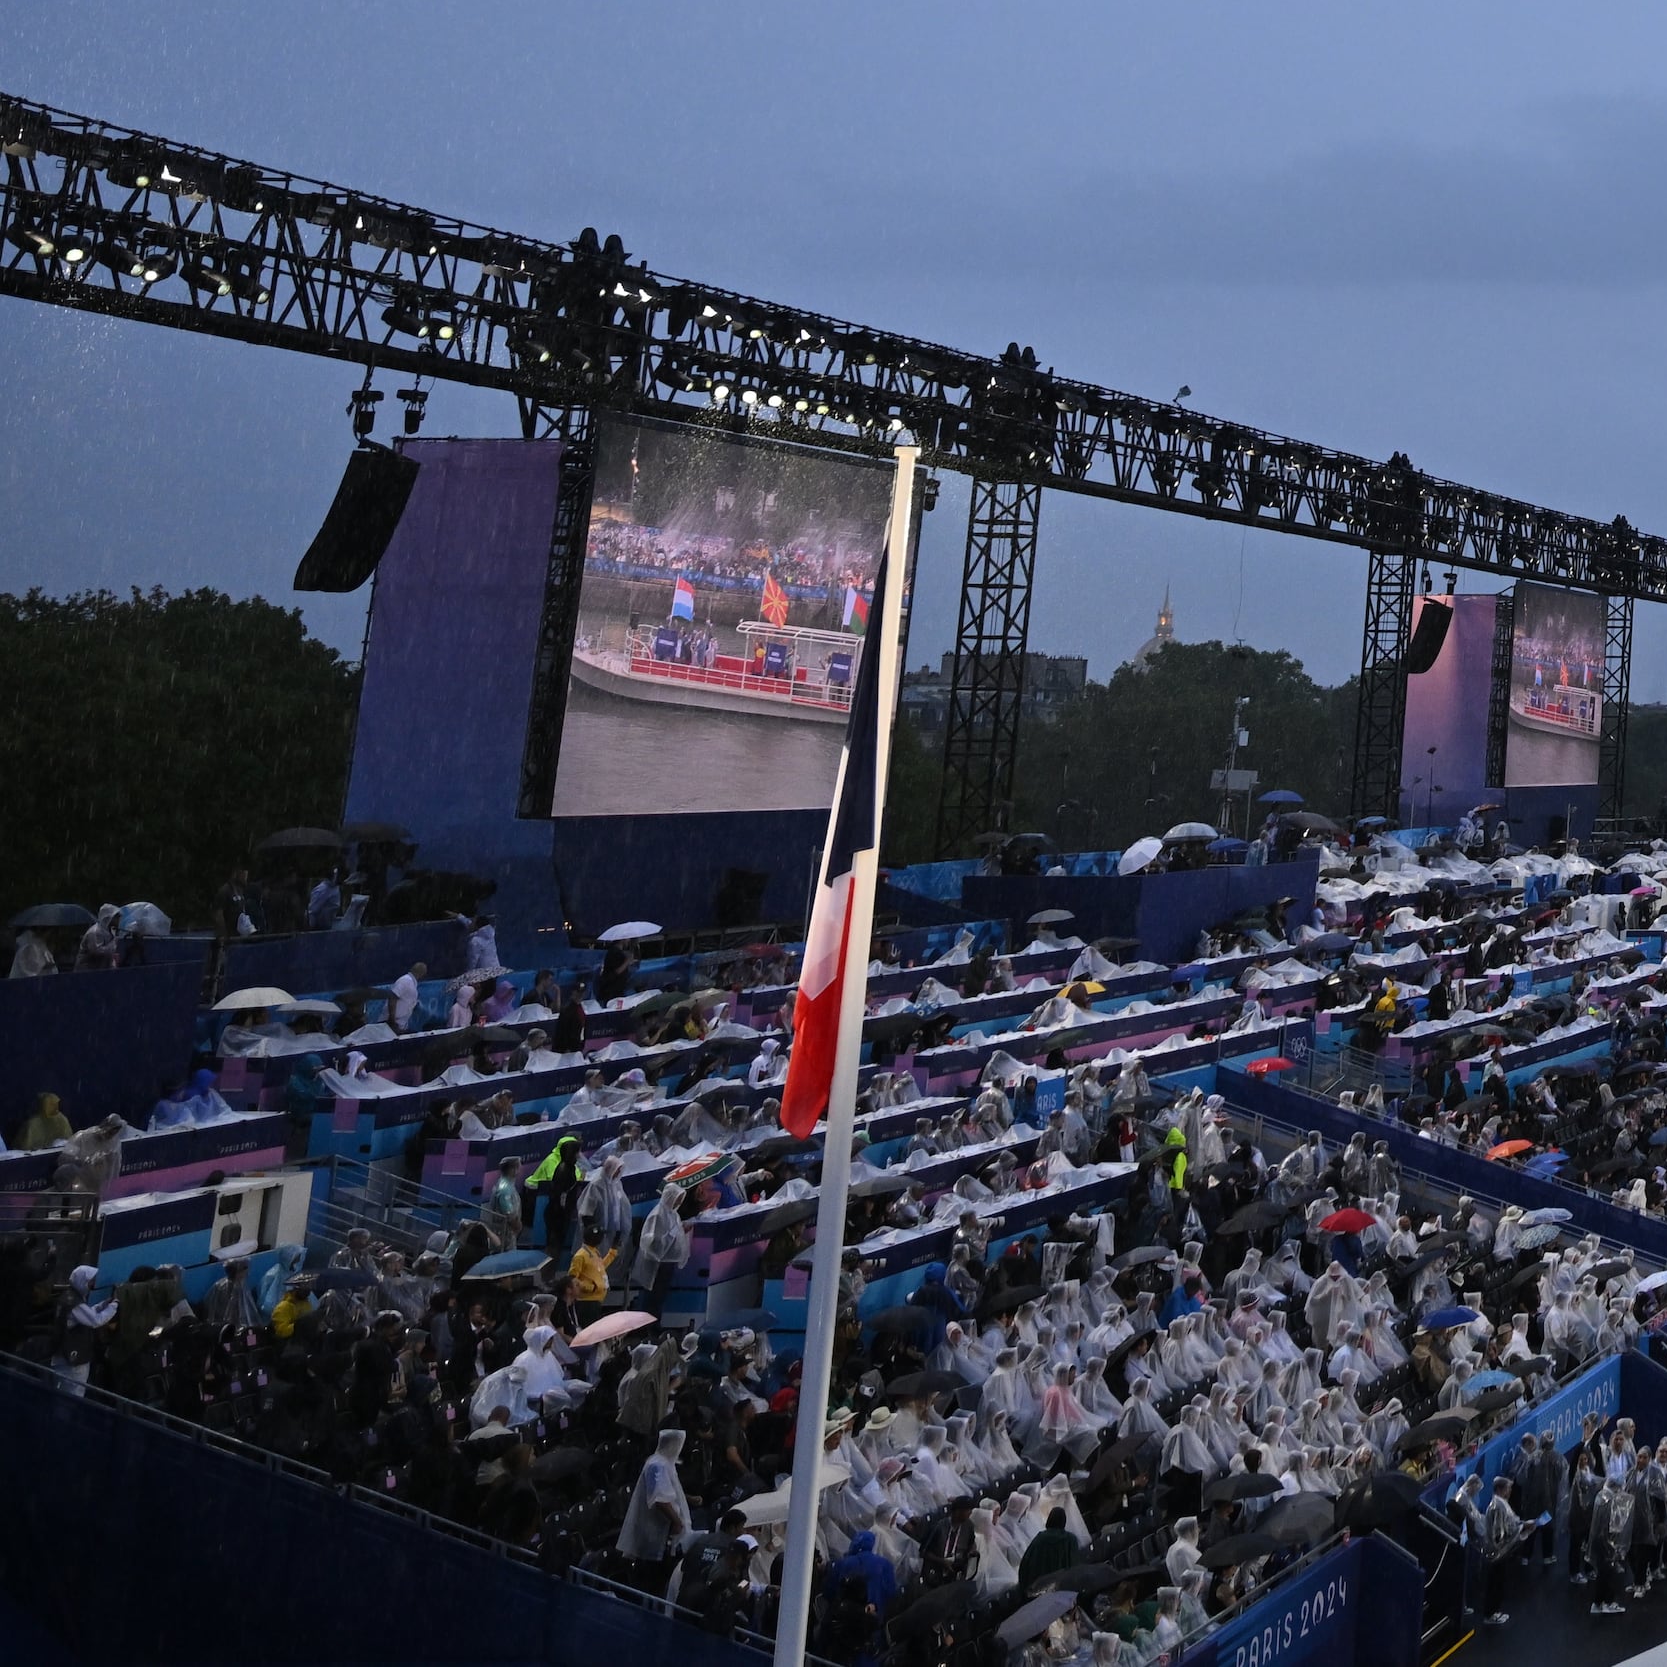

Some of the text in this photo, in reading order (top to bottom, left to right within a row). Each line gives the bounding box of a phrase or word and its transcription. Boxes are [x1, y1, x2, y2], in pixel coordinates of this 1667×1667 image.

[1036, 1092, 1056, 1111] ARIS
[1550, 1377, 1614, 1442] PARIS 2024
[1236, 1575, 1347, 1667] PARIS 2024
